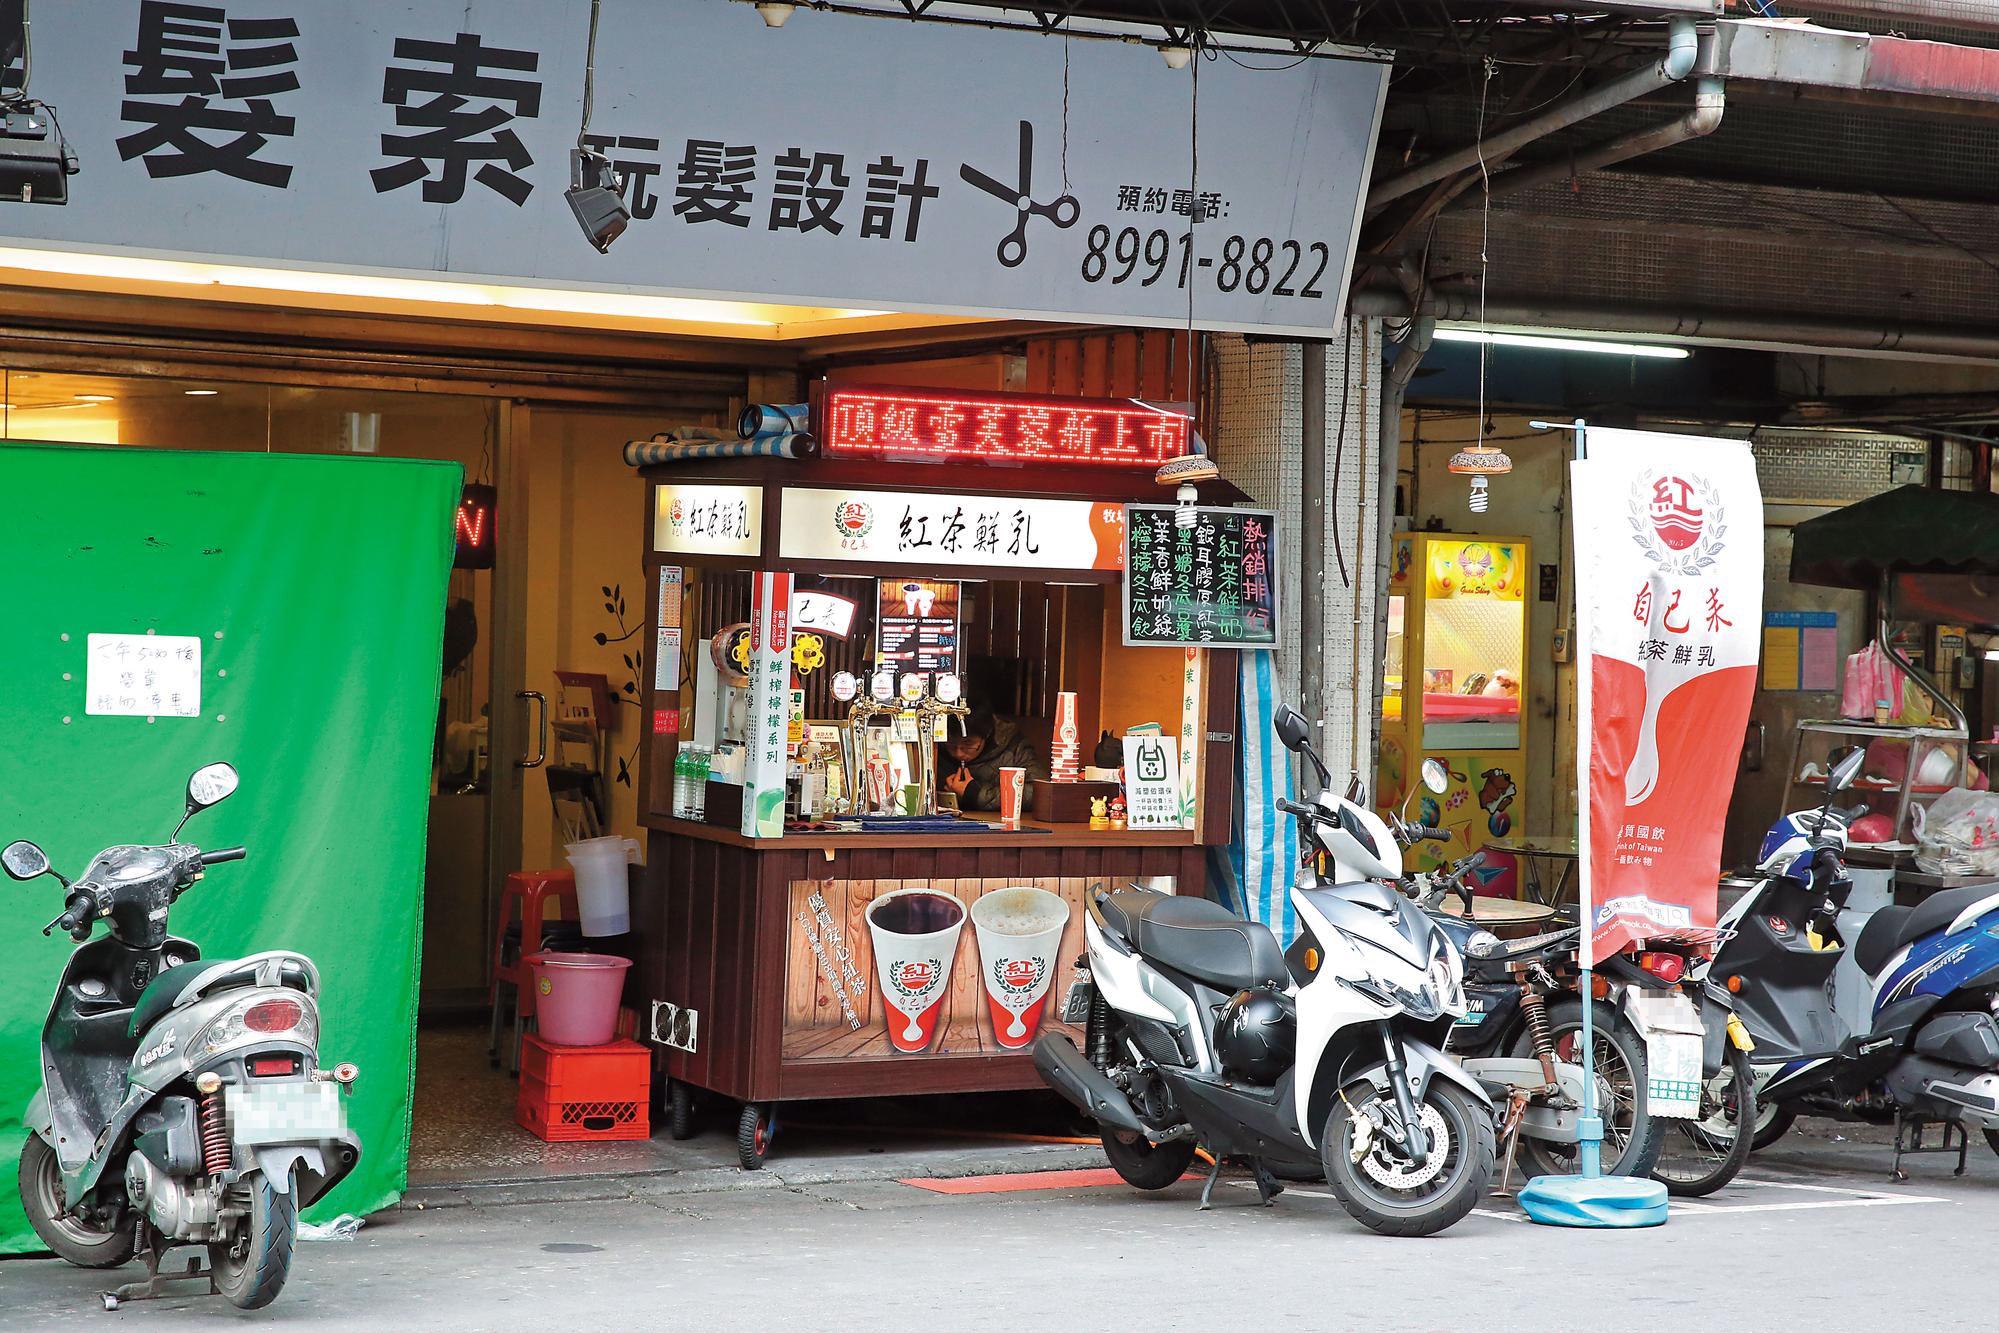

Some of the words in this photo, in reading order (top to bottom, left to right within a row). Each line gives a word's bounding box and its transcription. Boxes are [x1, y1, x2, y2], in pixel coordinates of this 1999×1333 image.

[583, 134, 939, 242] 玩髮設計
[1081, 224, 1329, 299] 8991-8822
[689, 499, 750, 540] 紅茶鮮乳
[898, 504, 1039, 556] 紅茶鮮乳
[1637, 843, 1663, 853] Taiwan
